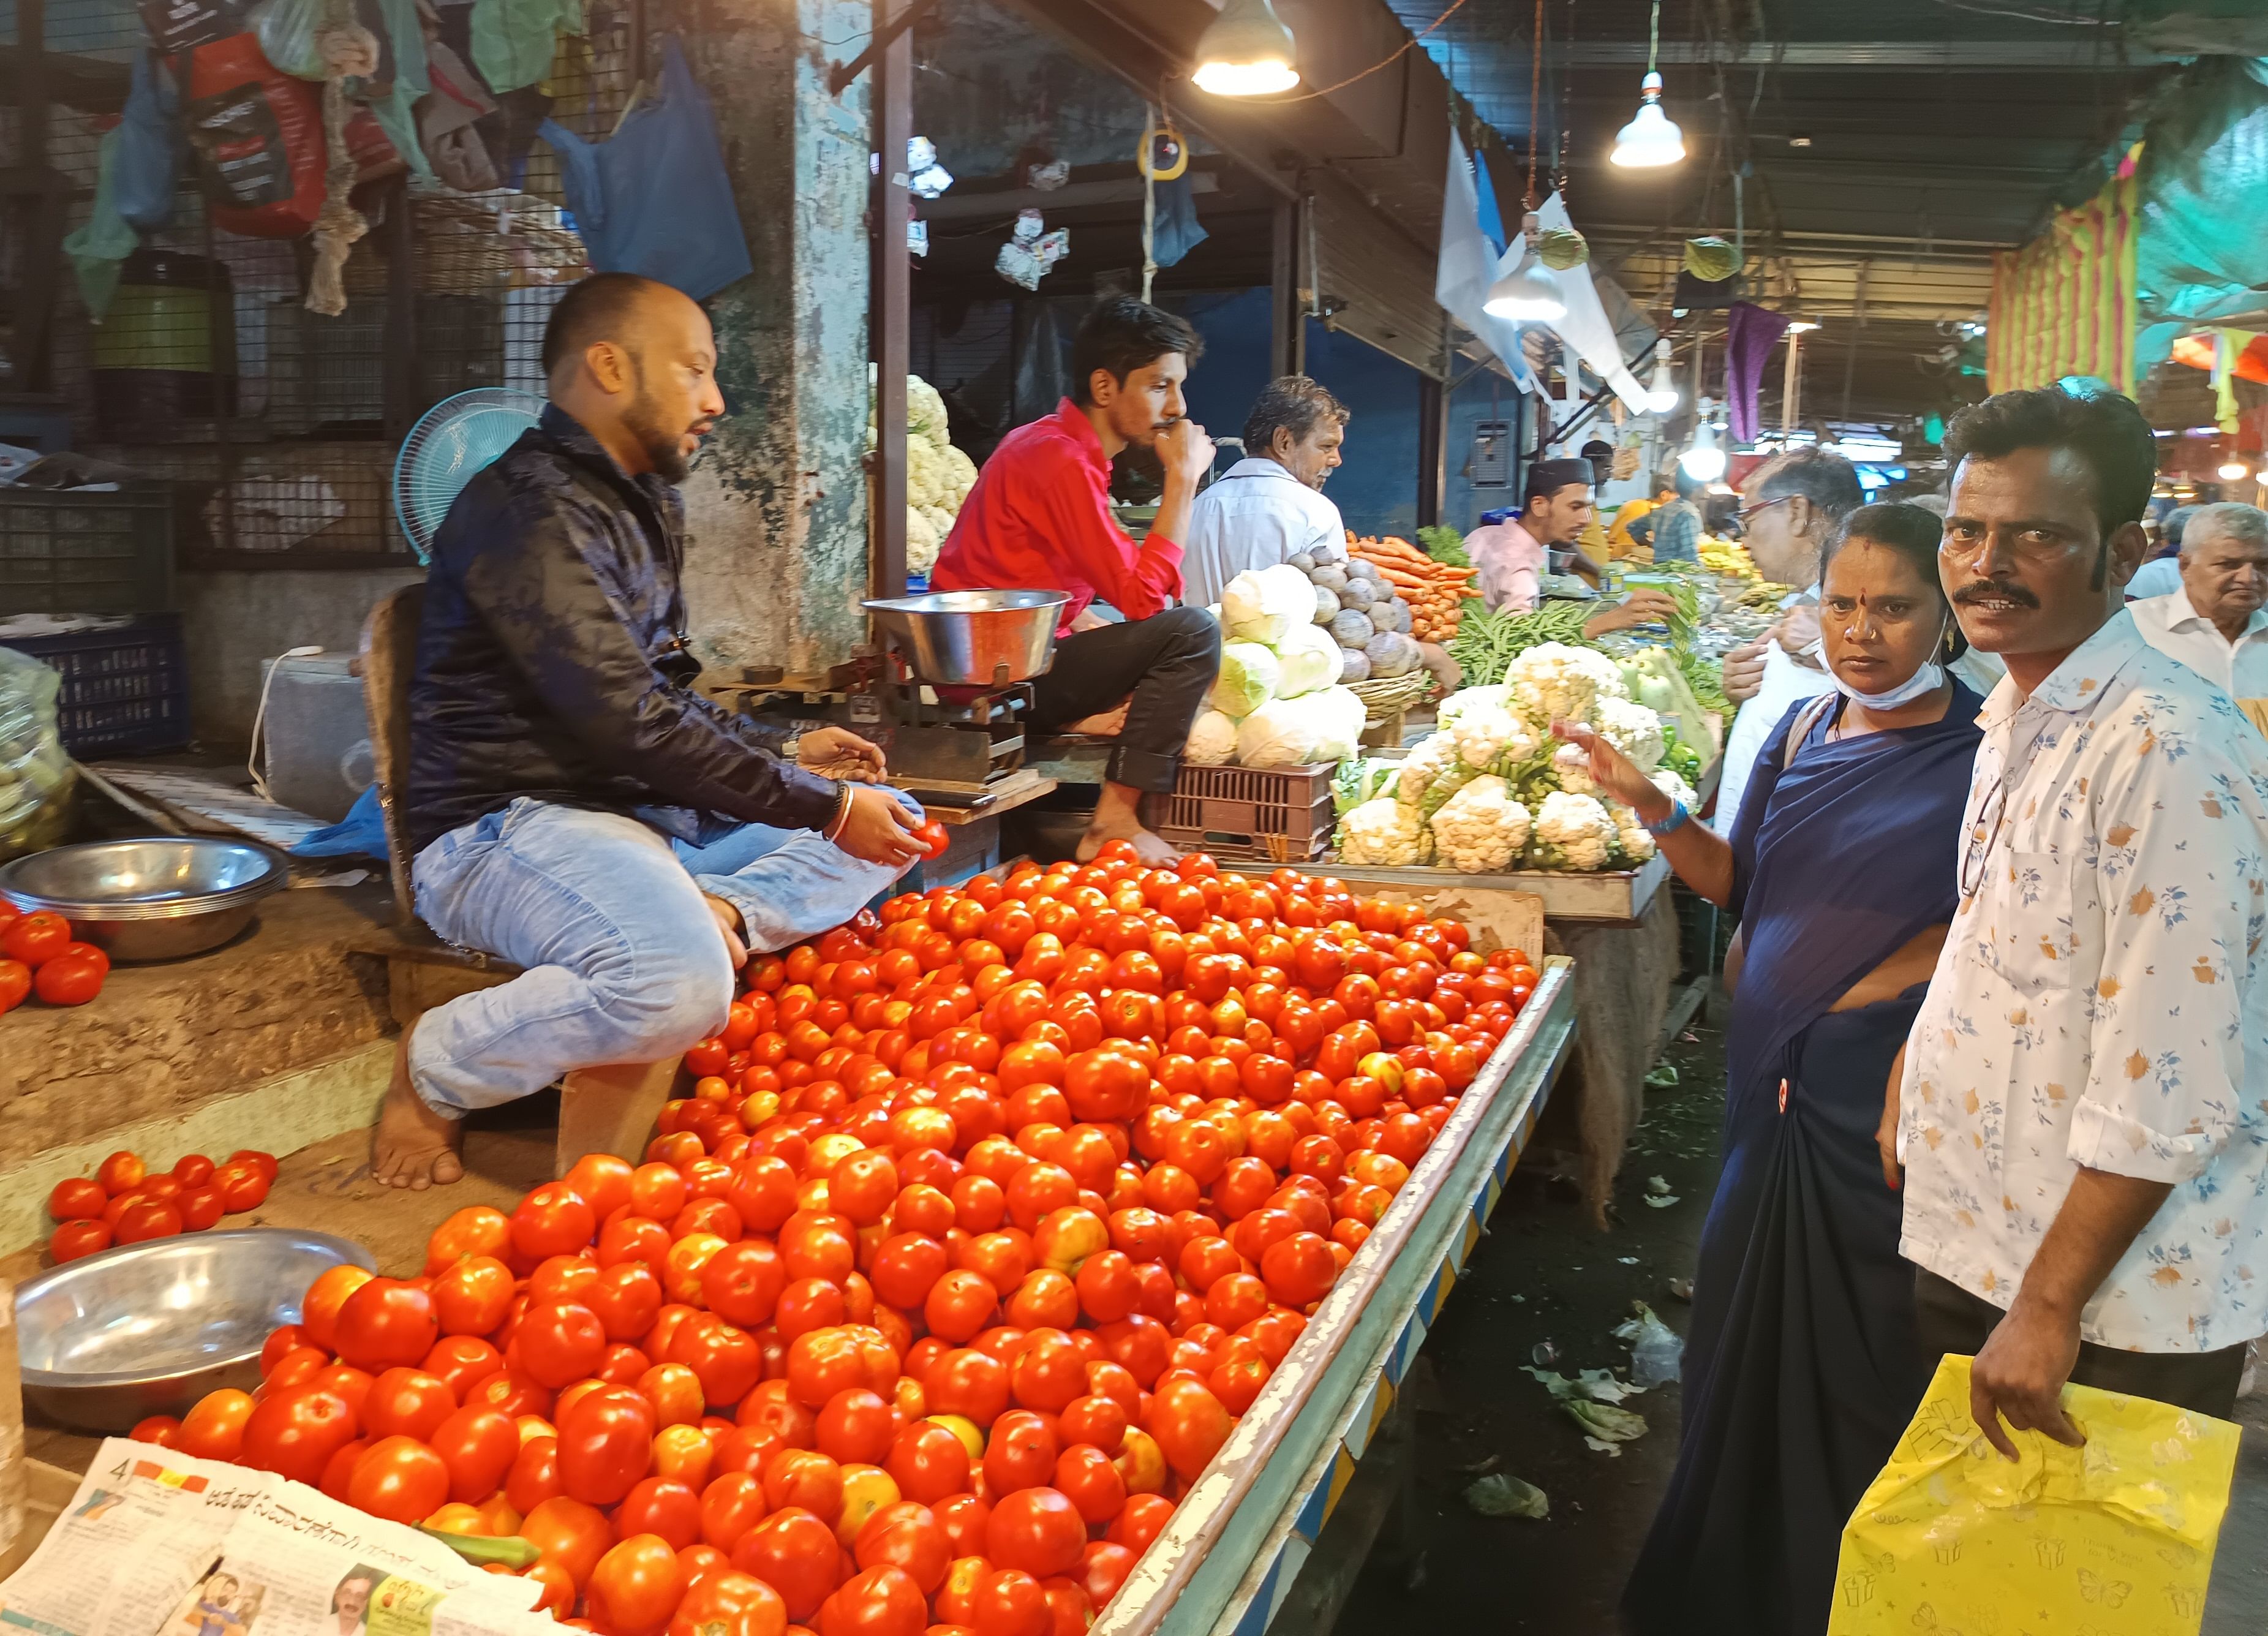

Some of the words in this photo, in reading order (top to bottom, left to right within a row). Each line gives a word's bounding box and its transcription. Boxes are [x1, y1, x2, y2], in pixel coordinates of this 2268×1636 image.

[110, 1458, 130, 1480] 4
[2081, 1536, 2117, 1553] Thank
[2120, 1550, 2143, 1564] you
[2089, 1548, 2101, 1556] for
